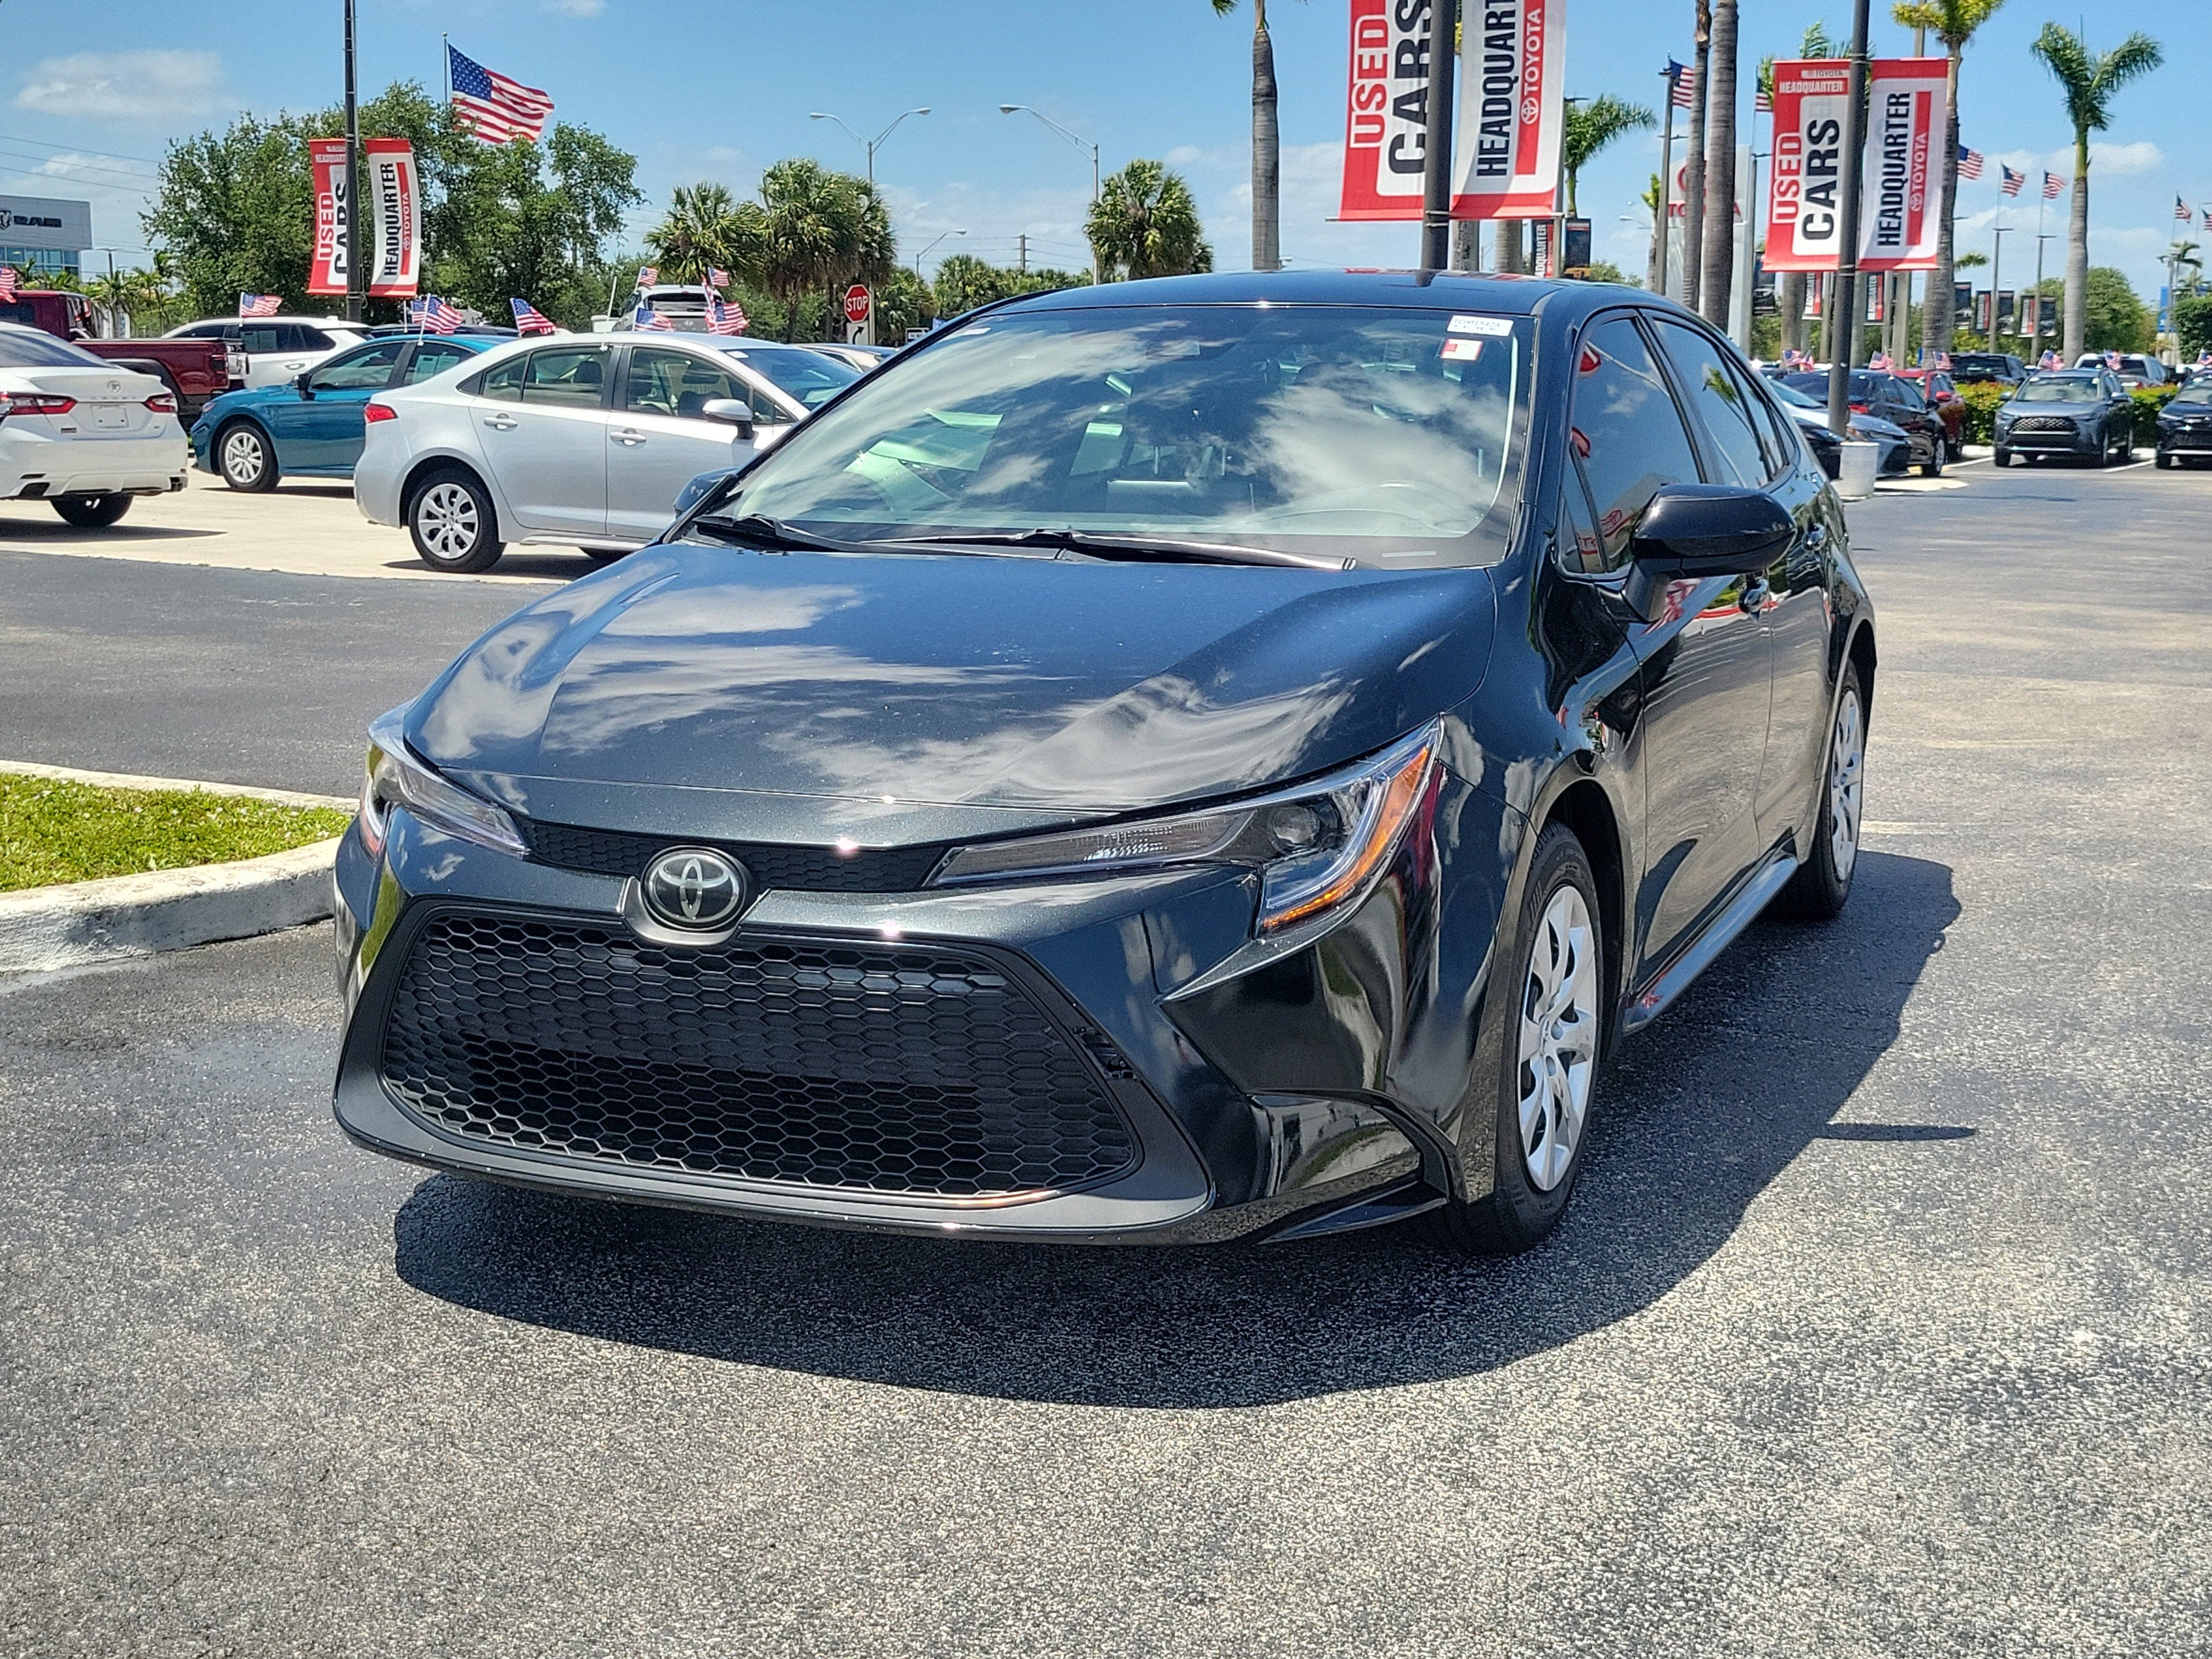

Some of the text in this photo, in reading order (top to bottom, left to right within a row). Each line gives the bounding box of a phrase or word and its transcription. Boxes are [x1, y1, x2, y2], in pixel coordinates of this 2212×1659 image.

[1353, 18, 1389, 145] USED
[1389, 0, 1431, 174] CARS
[1524, 8, 1542, 96] TOYOTA
[1779, 81, 1843, 94] HEADQUARTER
[1775, 135, 1802, 221] USED
[1802, 119, 1840, 240] CARS
[1877, 93, 1910, 246] HEADQUARTER
[1912, 132, 1927, 192] TOYOTA
[318, 194, 334, 259] USED
[380, 163, 402, 275] HEADQUARTER
[402, 193, 410, 238] TOYOTA
[847, 296, 868, 312] STOP
